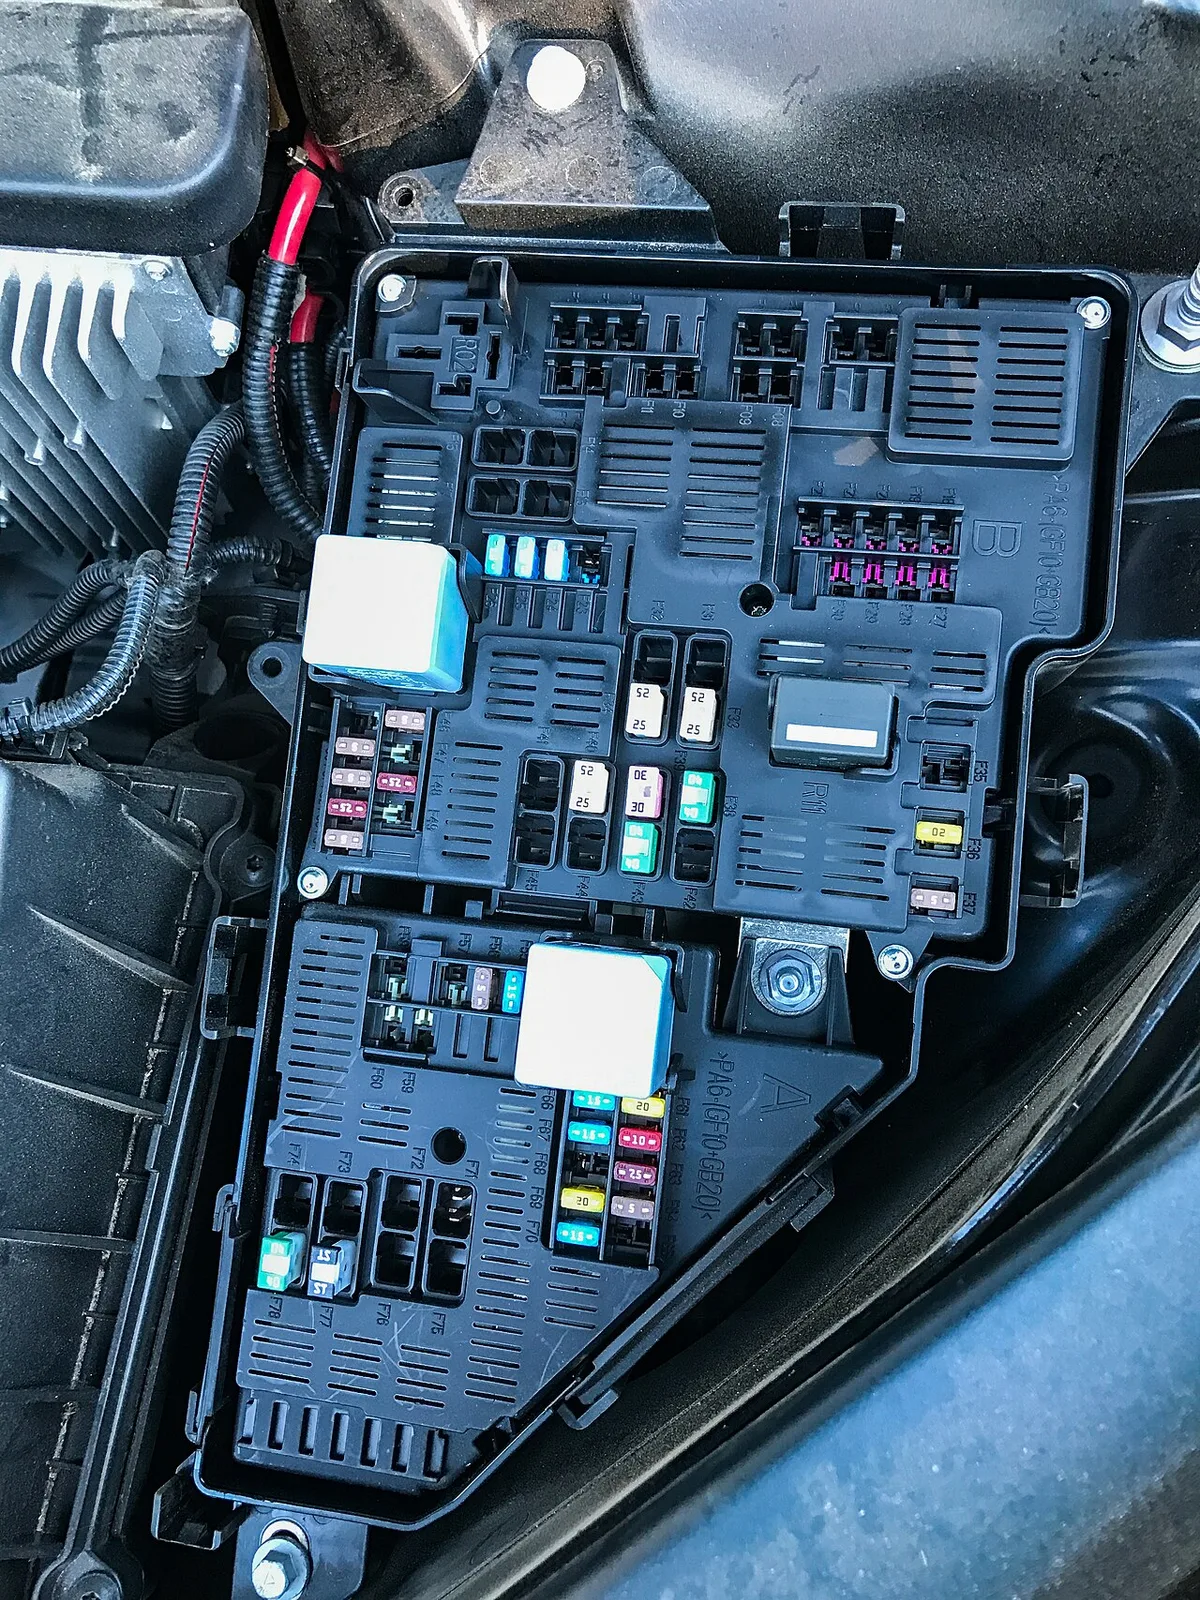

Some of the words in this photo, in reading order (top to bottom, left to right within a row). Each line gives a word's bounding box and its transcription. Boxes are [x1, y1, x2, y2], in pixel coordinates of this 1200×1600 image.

[454, 339, 478, 371] R02
[640, 399, 655, 414] F11
[672, 400, 687, 418] F10
[738, 404, 753, 426] F09
[771, 405, 786, 428] F08
[972, 519, 1023, 558] B
[576, 592, 592, 616] F23
[650, 600, 666, 622] F32
[899, 603, 914, 626] F28
[933, 606, 949, 629] F27
[636, 687, 650, 698] 25
[691, 691, 706, 703] 25
[632, 719, 647, 731] 25
[687, 723, 701, 736] 25
[727, 706, 742, 730] F33
[536, 725, 550, 746] F41
[584, 730, 599, 753] F40
[434, 741, 450, 765] F47
[674, 749, 688, 773] F39
[579, 765, 594, 777] 25
[633, 769, 648, 781] 30
[974, 759, 990, 784] F35
[575, 796, 590, 809] 25
[630, 801, 645, 813] 30
[800, 781, 830, 815] R11
[931, 827, 947, 838] 20
[966, 837, 983, 861] F36
[525, 868, 540, 892] F45
[575, 873, 591, 898] F44
[631, 880, 646, 904] F43
[683, 886, 699, 910] F42
[930, 894, 939, 906] 5
[962, 891, 979, 917] F37
[457, 932, 474, 955] F57
[488, 935, 503, 959] F56
[477, 983, 487, 993] 5
[506, 984, 518, 1000] 15
[370, 1066, 386, 1091] F60
[401, 1070, 418, 1094] F59
[540, 1089, 555, 1111] F66
[587, 1094, 601, 1107] 15
[760, 1073, 812, 1114] A
[636, 1100, 650, 1112] 20
[675, 1096, 691, 1118] F61
[537, 1118, 553, 1142] F67
[582, 1127, 597, 1141] 15
[631, 1134, 646, 1147] 10
[671, 1127, 688, 1152] F62
[287, 1142, 302, 1168] F74
[336, 1149, 354, 1174] F73
[410, 1146, 427, 1171] F72
[532, 1151, 549, 1176] F68
[464, 1158, 480, 1179] F71
[529, 1185, 546, 1211] F69
[576, 1195, 590, 1208] 20
[627, 1202, 637, 1215] 5
[524, 1219, 541, 1244] F70
[569, 1227, 585, 1242] 15
[268, 1295, 284, 1319] F78
[318, 1304, 335, 1330] F77
[376, 1301, 393, 1327] F76
[430, 1311, 447, 1337] F75
